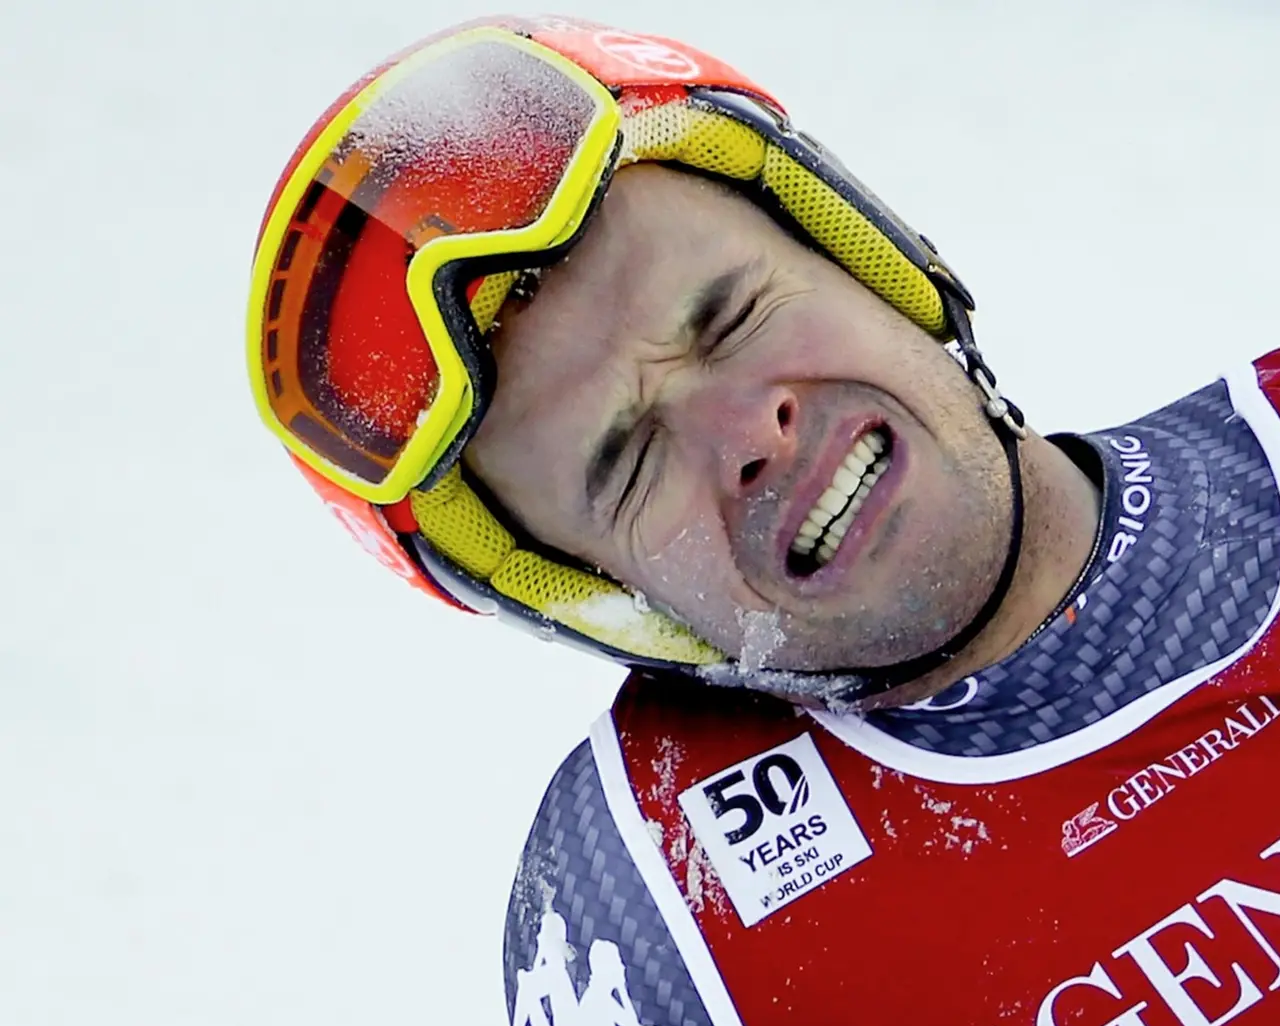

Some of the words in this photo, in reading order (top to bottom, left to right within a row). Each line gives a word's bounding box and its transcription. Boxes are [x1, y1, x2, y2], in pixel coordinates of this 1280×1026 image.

[702, 753, 810, 846] 50
[740, 815, 828, 873] YEARS
[794, 847, 820, 867] SKI
[815, 853, 844, 877] CUP
